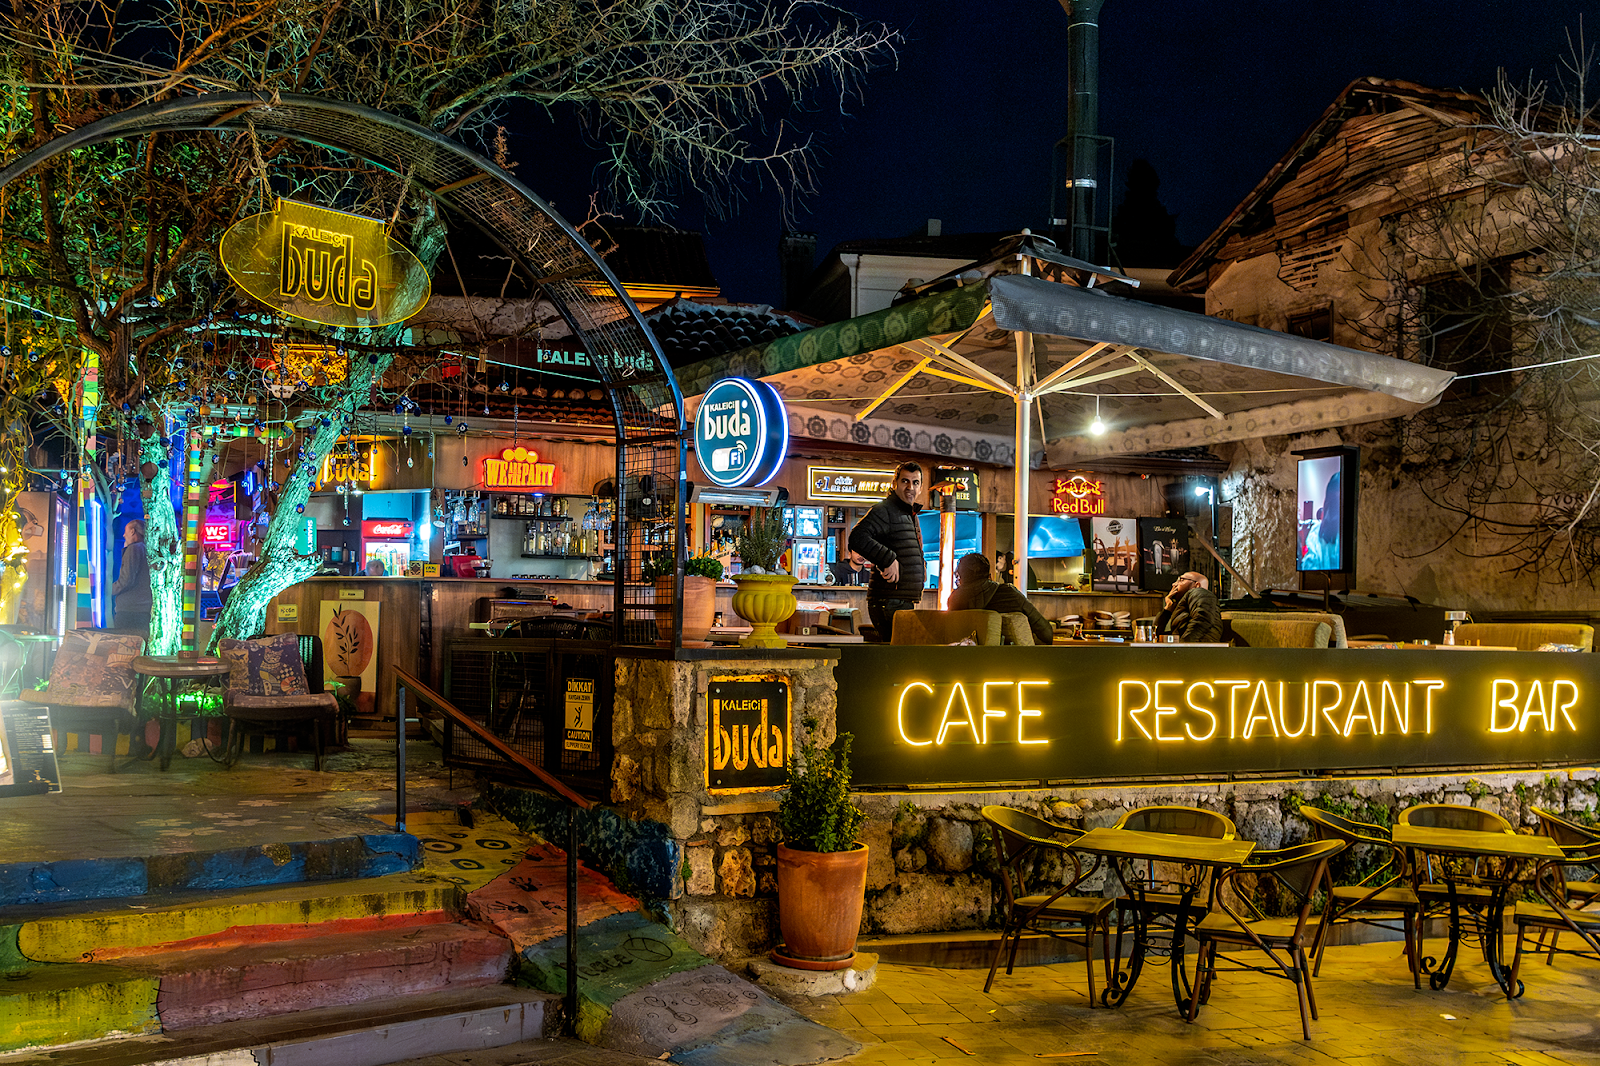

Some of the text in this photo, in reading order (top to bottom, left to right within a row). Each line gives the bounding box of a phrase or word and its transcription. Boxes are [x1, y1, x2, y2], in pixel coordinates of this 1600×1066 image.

[280, 222, 378, 311] buda
[704, 400, 751, 440] buda
[486, 459, 508, 486] WE
[521, 462, 555, 486] PARTY
[1053, 497, 1105, 514] Red Bull
[205, 526, 228, 536] WC
[897, 679, 1578, 745] CAFE RESTAURANT BAR
[567, 730, 591, 740] CAUTION
[713, 699, 783, 770] buda
